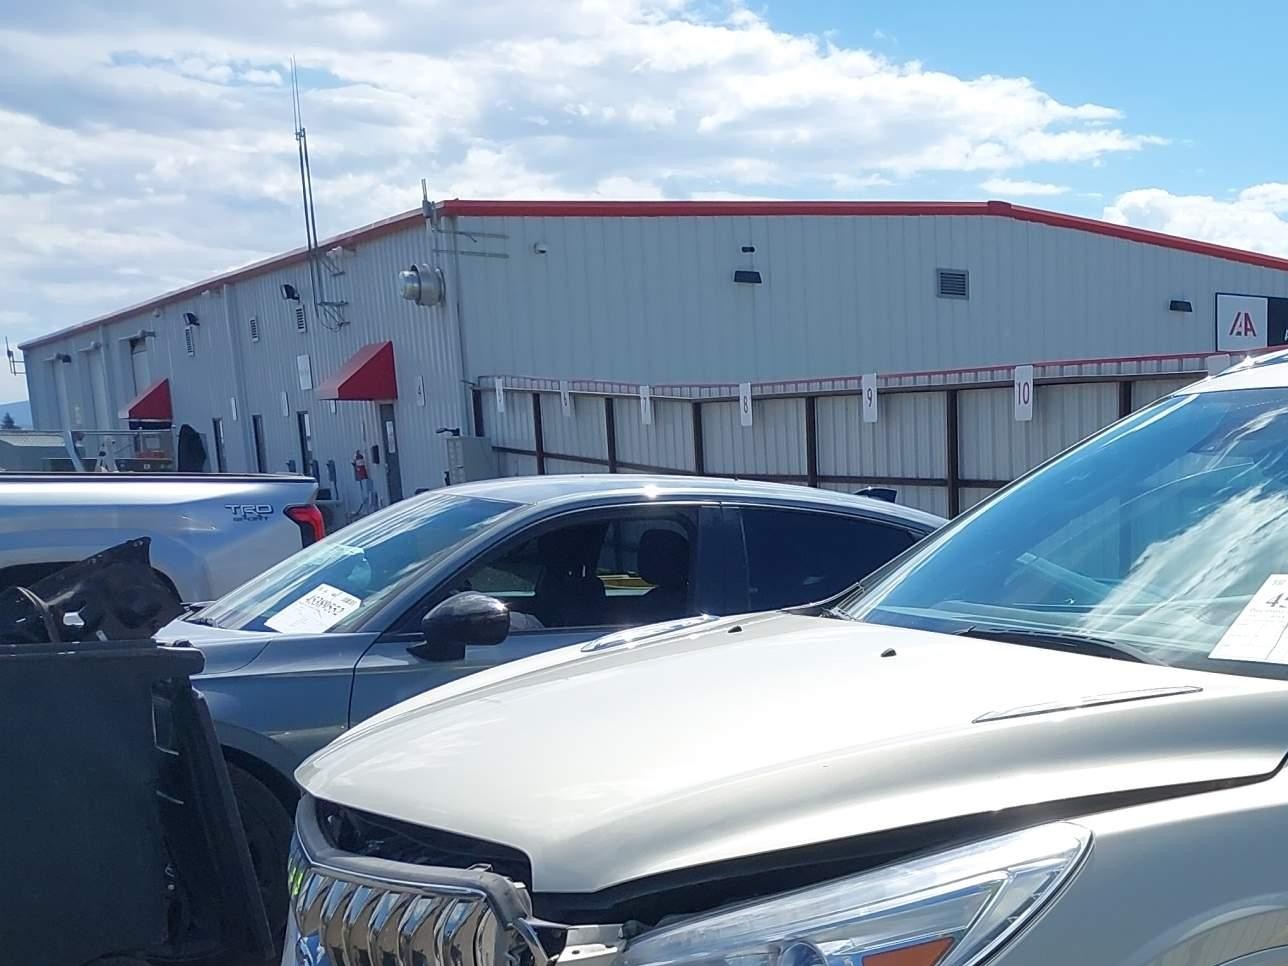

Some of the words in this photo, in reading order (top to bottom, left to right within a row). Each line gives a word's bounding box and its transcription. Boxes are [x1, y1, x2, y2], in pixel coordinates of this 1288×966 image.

[866, 387, 873, 408] 9
[1017, 382, 1030, 405] 10
[743, 395, 749, 414] 8
[224, 504, 274, 517] TRD
